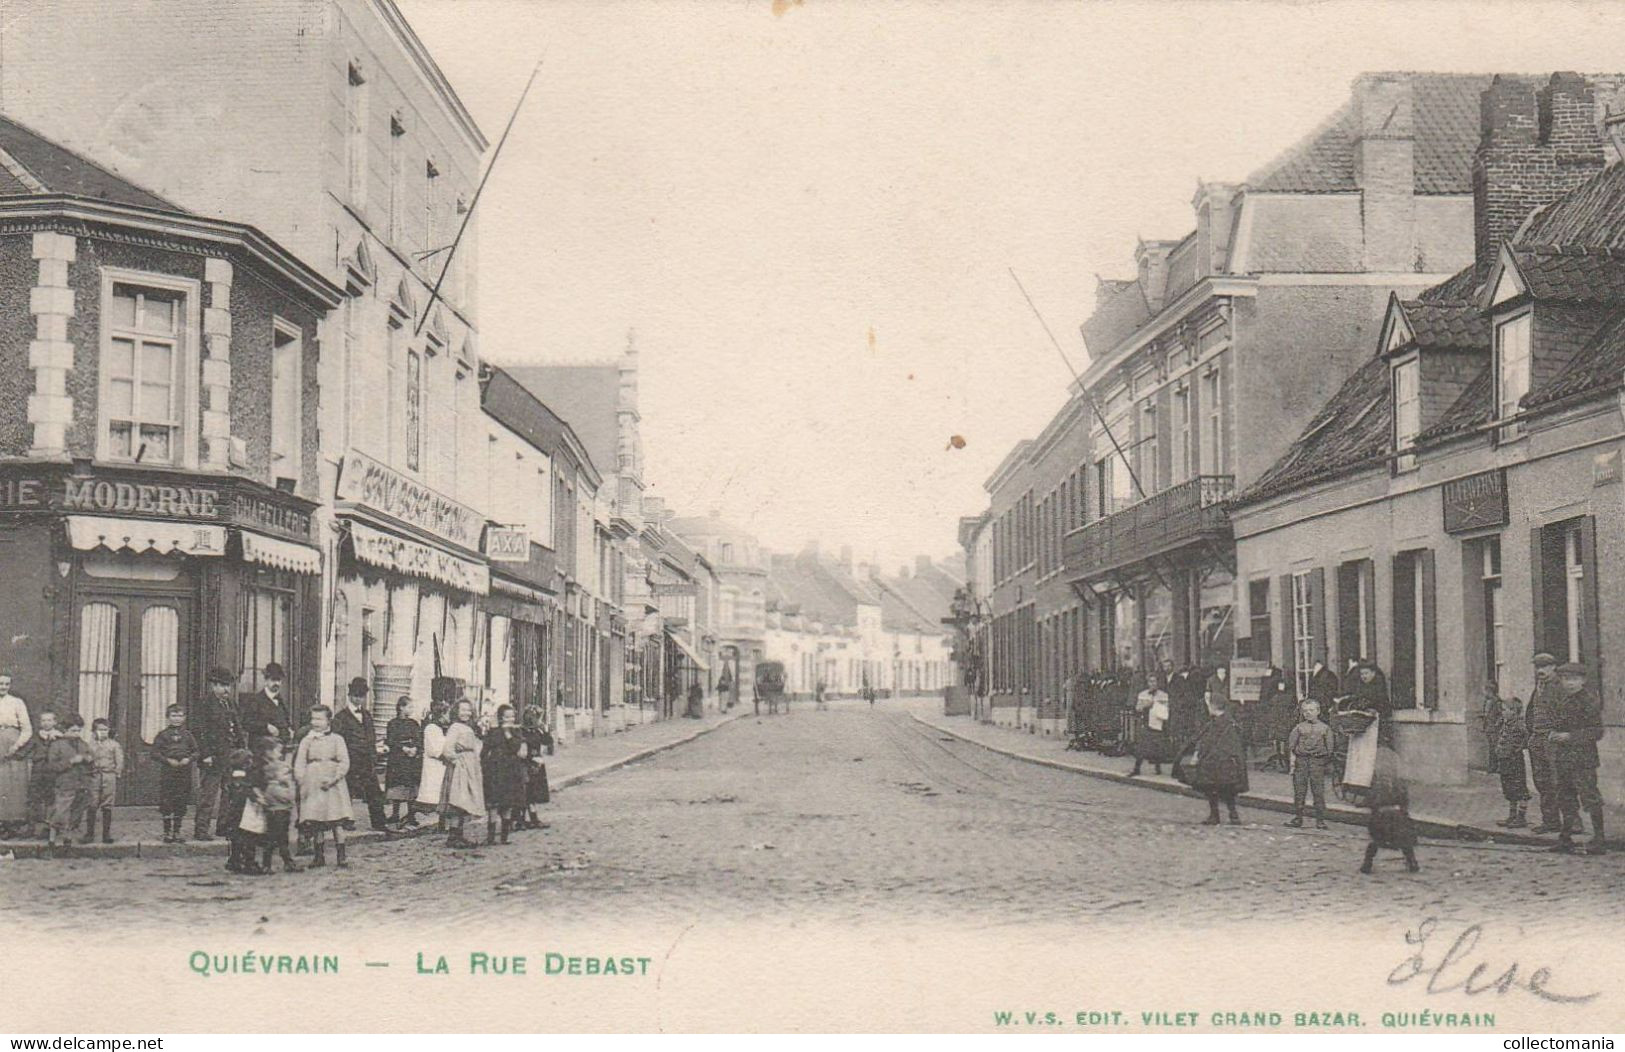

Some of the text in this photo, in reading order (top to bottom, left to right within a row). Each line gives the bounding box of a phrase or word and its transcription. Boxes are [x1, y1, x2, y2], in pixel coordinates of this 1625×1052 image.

[63, 478, 220, 517] MODERNE
[234, 494, 311, 536] CHAPELLERIE
[489, 533, 526, 553] AXA
